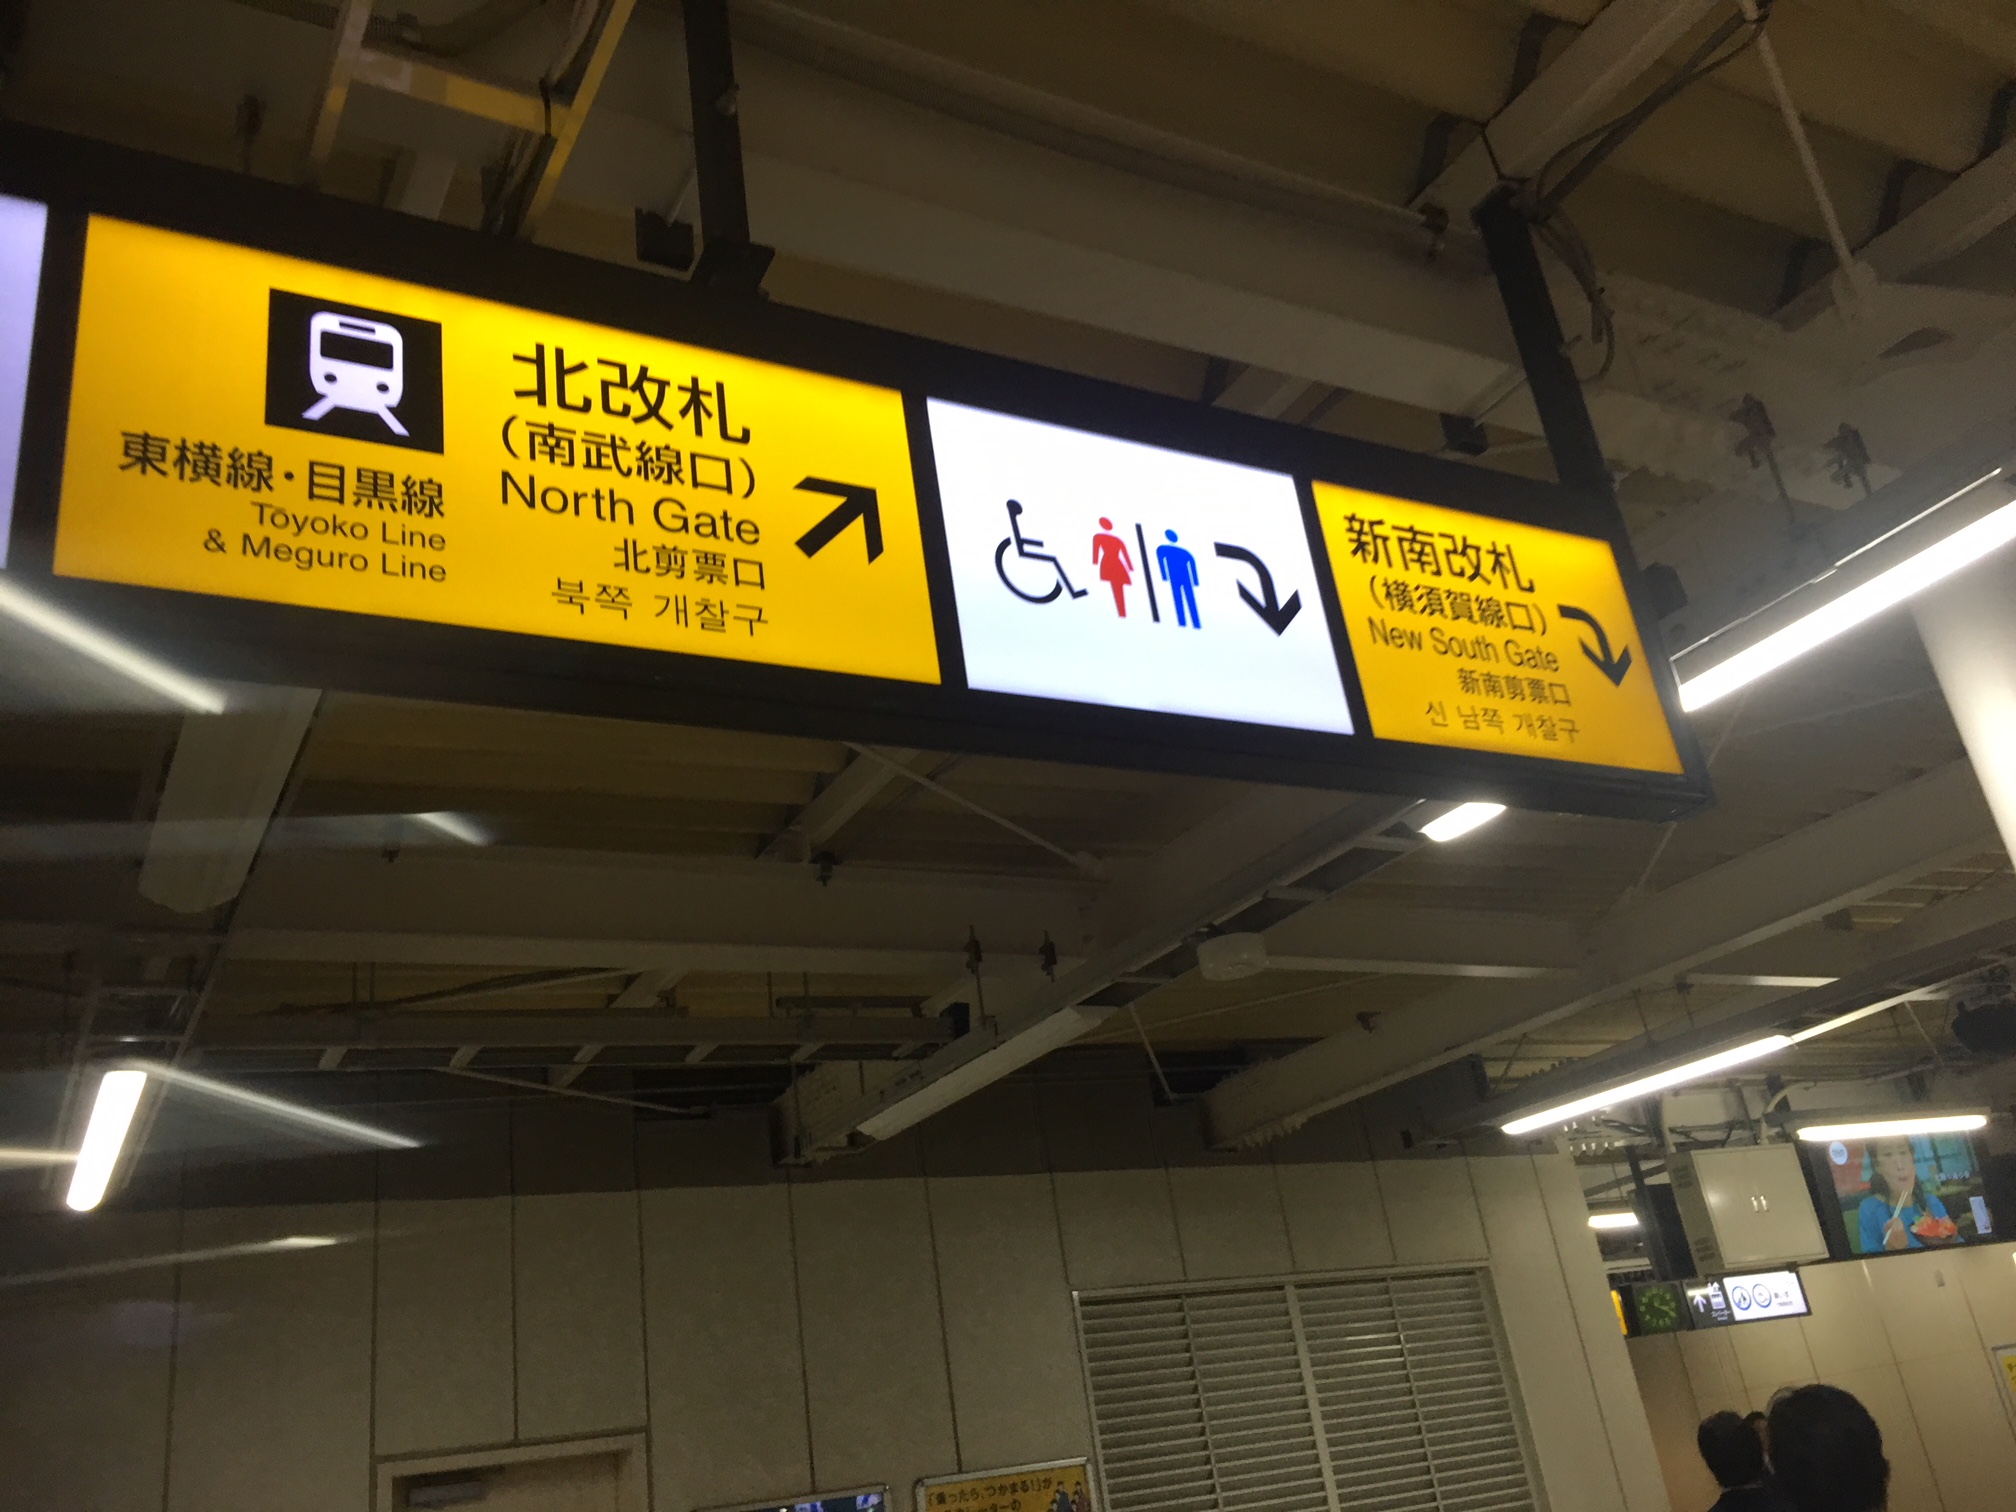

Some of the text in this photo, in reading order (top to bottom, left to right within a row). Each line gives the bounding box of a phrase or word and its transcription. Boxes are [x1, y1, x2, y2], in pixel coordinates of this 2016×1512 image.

[512, 342, 751, 444] 北改札
[119, 431, 445, 518] 東横線・目黒線
[501, 415, 755, 499] (南武線口)
[381, 521, 446, 551] Line
[501, 470, 760, 545] North Gate
[203, 528, 447, 582] & Meguro Line
[614, 538, 766, 590] 北剪票口
[1343, 513, 1536, 593] 新南改札
[551, 577, 769, 636] 북쪽 개찰구
[1367, 616, 1560, 672] New South Gate
[1425, 701, 1580, 743] 신 남쪽 개찰구
